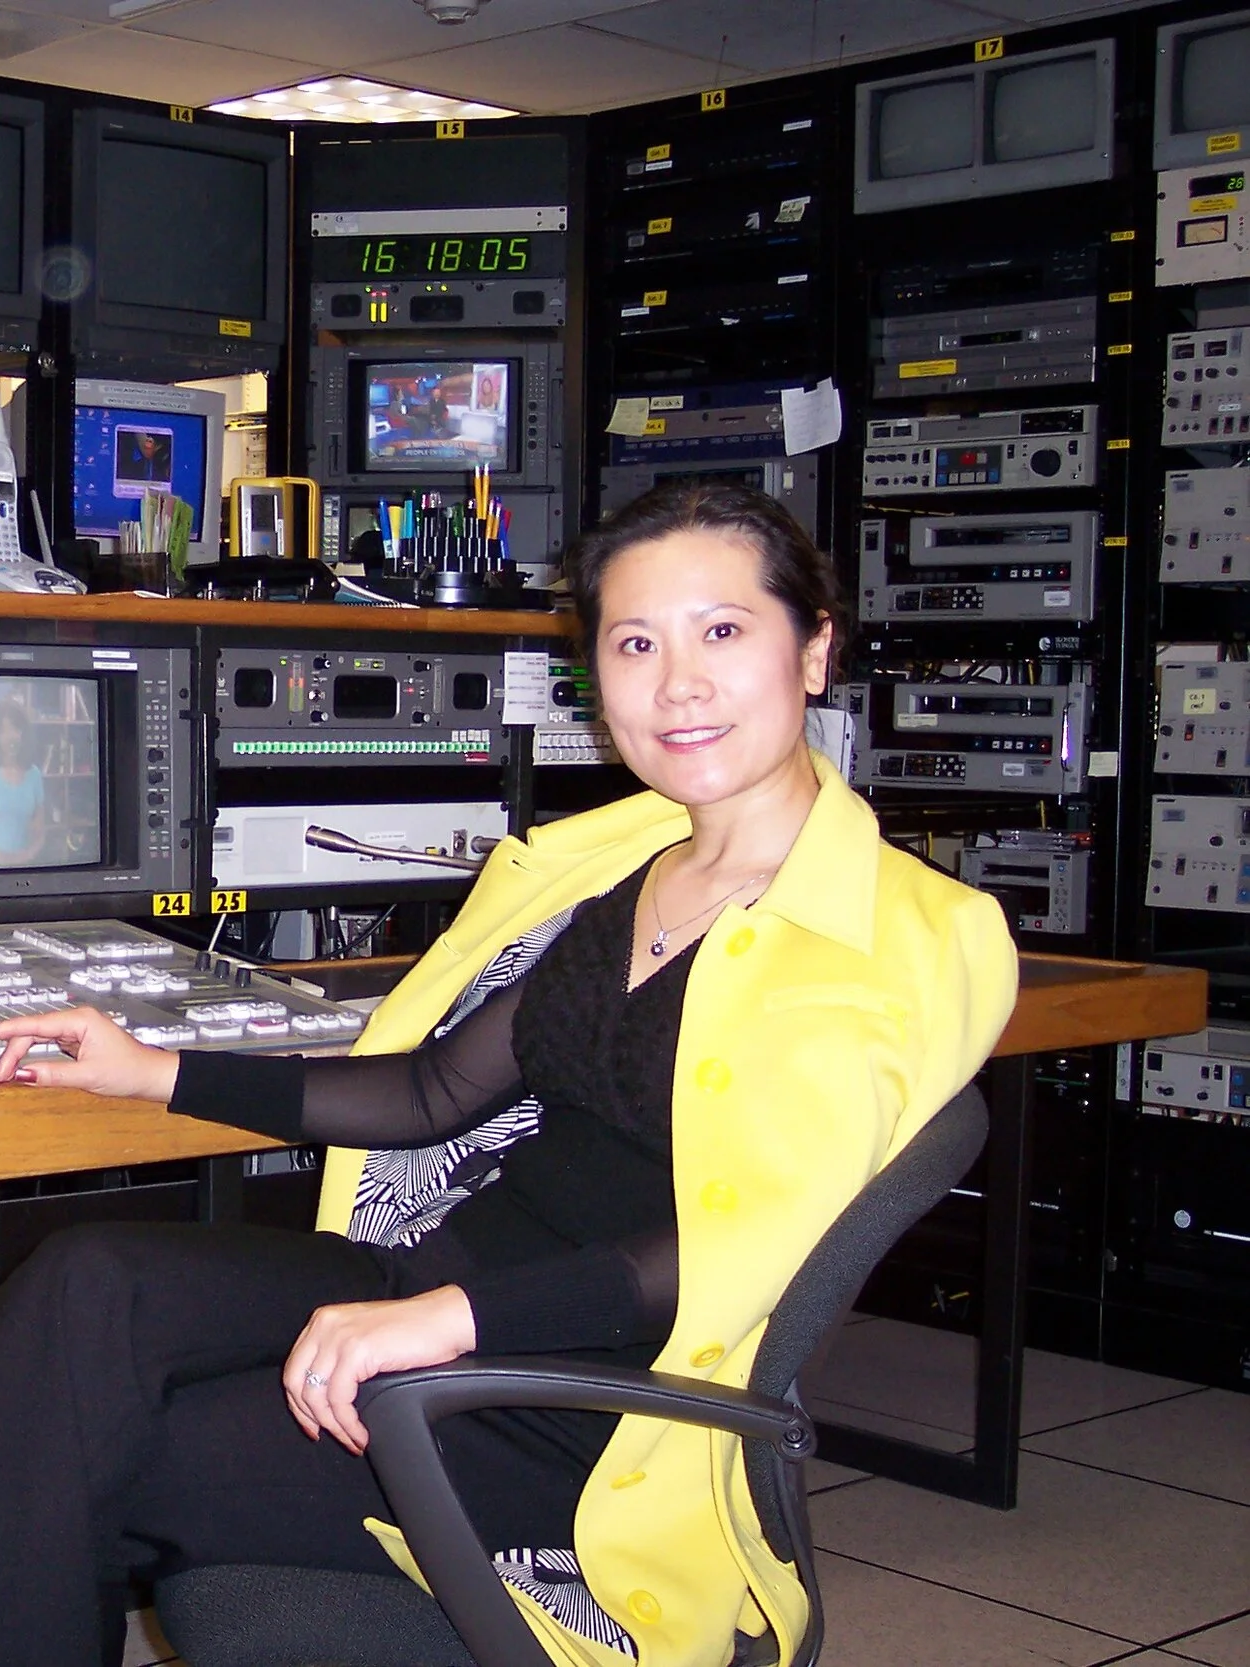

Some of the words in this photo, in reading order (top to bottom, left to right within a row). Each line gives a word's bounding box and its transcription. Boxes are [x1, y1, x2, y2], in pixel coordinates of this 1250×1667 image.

[981, 40, 1000, 56] 17
[706, 92, 722, 107] 16
[175, 108, 190, 121] 14
[443, 123, 460, 135] 15
[159, 895, 185, 915] 24
[216, 892, 241, 912] 25
